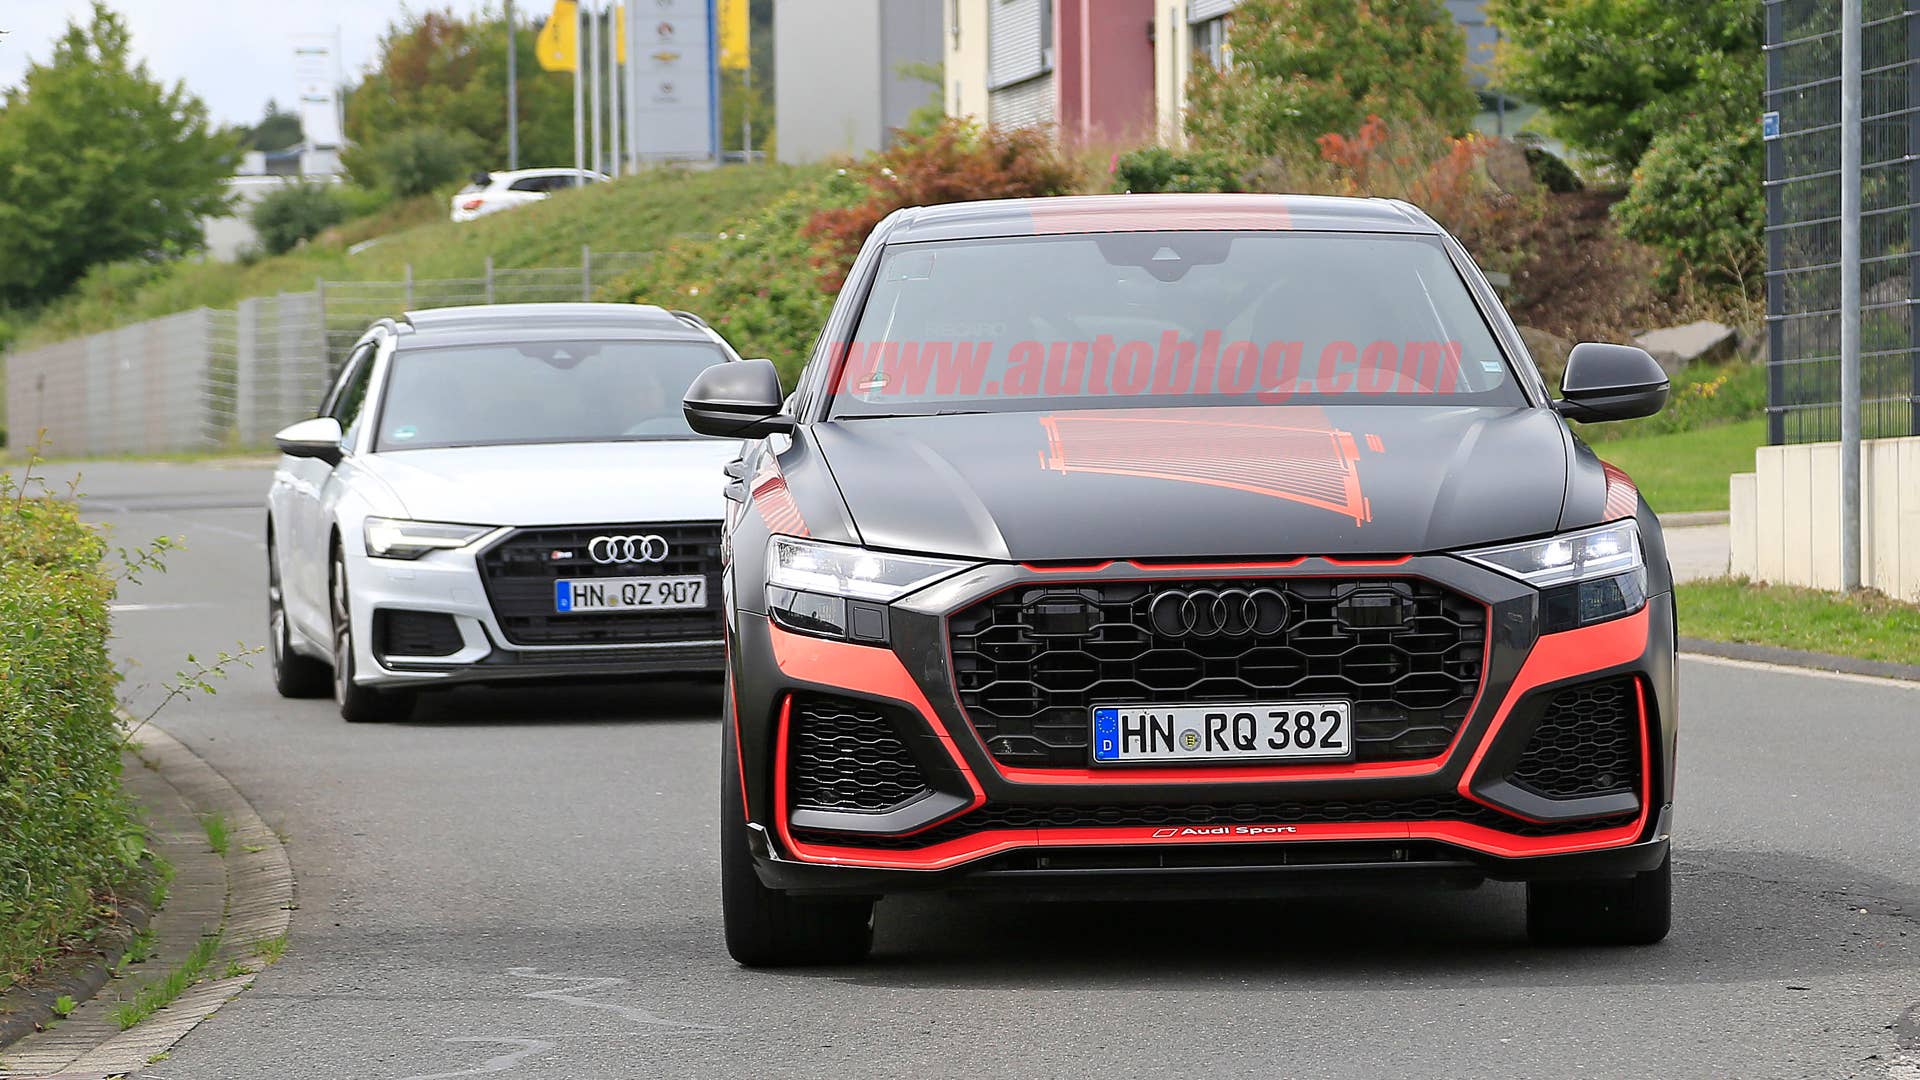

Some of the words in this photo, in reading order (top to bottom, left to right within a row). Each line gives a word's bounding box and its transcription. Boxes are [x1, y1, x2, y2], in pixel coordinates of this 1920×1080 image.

[573, 584, 605, 607] HN
[622, 583, 652, 606] QZ
[659, 581, 702, 604] 907
[1121, 714, 1175, 753] HN
[1205, 712, 1257, 752] RQ
[1267, 710, 1343, 749] 382
[1103, 739, 1112, 751] D
[1181, 826, 1230, 836] Audi
[1235, 825, 1297, 836] Sport
